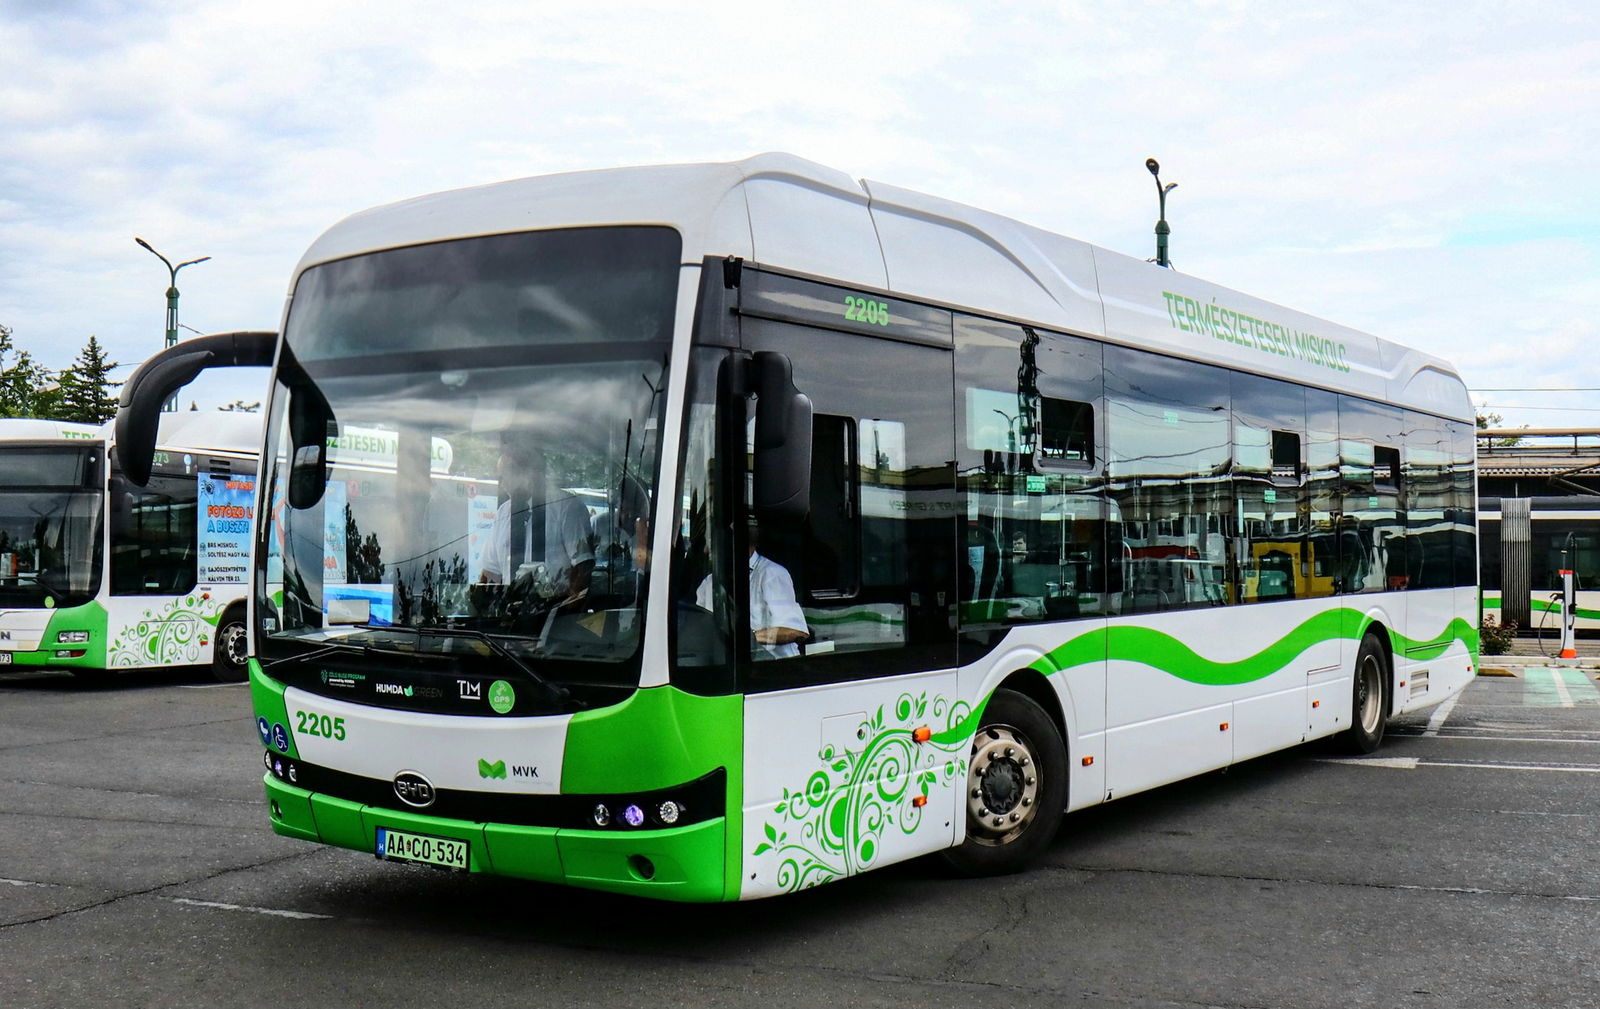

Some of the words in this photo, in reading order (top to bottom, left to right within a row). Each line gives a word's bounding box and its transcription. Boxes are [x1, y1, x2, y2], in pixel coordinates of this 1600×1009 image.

[844, 296, 889, 327] 2205
[1162, 291, 1296, 359] TERMÉSZETESEN
[1295, 330, 1350, 374] MISKOLC
[207, 502, 245, 519] FOTÓZD
[207, 520, 215, 534] A
[216, 521, 249, 534] BUSZT!
[375, 683, 404, 695] HUMDA
[414, 687, 444, 698] GREEN
[296, 710, 346, 741] 2205
[512, 765, 539, 778] MVK
[396, 780, 430, 799] BYD
[379, 843, 384, 851] H
[387, 833, 405, 856] AA
[411, 838, 464, 865] CO-534
